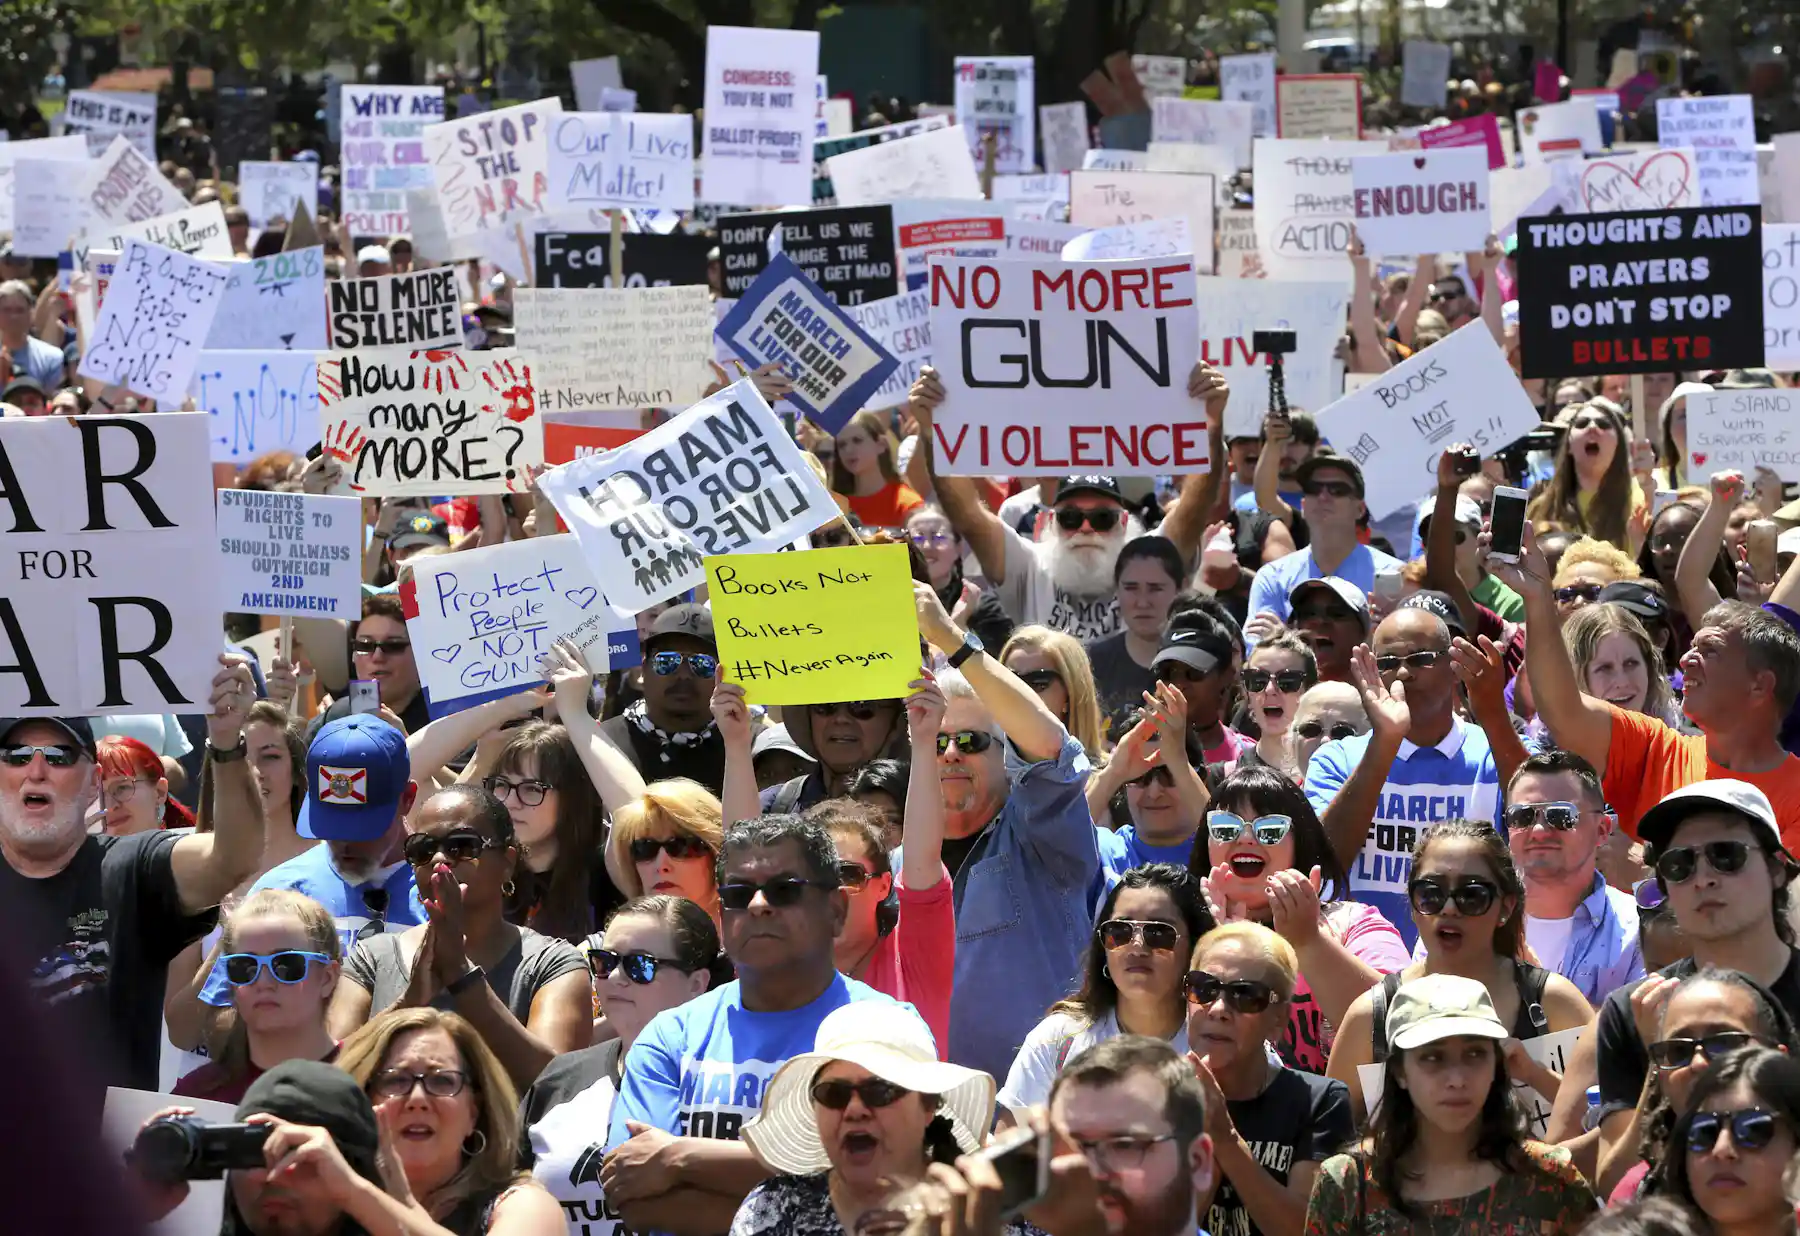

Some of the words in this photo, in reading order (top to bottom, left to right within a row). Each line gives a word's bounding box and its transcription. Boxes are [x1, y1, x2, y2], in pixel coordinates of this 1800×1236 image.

[723, 69, 796, 86] CONGRESS:
[352, 93, 403, 116] WHY
[770, 92, 794, 108] NOT
[457, 112, 538, 157] STOP
[555, 117, 610, 154] Our
[628, 120, 690, 160] Lives
[476, 154, 521, 181] THE
[566, 162, 665, 199] Matter!
[1094, 184, 1134, 206] The
[1354, 181, 1487, 218] ENOUGH.
[820, 223, 841, 239] US
[849, 222, 873, 238] WE
[1278, 222, 1350, 250] ACTIO
[1528, 216, 1682, 248] THOUGHTS
[1692, 213, 1752, 238] AND
[254, 249, 320, 285] 2018
[544, 234, 625, 269] Fea
[726, 253, 757, 270] CAN
[839, 245, 868, 259] THE
[824, 265, 851, 281] GET
[856, 262, 891, 278] MAD
[931, 264, 1001, 310] NO
[1032, 263, 1194, 312] MORE
[1569, 256, 1710, 289] PRAYERS
[330, 279, 379, 314] NO
[390, 270, 457, 311] MORE
[333, 305, 457, 349] SILENCE
[778, 290, 852, 361] MARCH
[1550, 297, 1636, 329] DON'T
[1650, 294, 1731, 322] STOP
[105, 314, 191, 360] NOT
[763, 307, 806, 353] FOR
[798, 343, 848, 388] OUR
[961, 317, 1171, 389] GUN
[1202, 337, 1285, 366] LIV
[1572, 336, 1711, 365] BULLETS
[748, 325, 806, 384] LIVES
[1373, 359, 1448, 409] BOOKS
[368, 398, 478, 437] many
[1412, 400, 1451, 436] NOT
[1705, 396, 1720, 416] I
[1731, 394, 1791, 414] STAND
[1722, 417, 1764, 431] with
[353, 425, 525, 485] MORE?
[932, 421, 1210, 467] VIOLENCE
[1752, 449, 1800, 465] VIOLENC
[222, 490, 304, 511] STUDENTS
[243, 507, 305, 526] RIGHTS
[311, 512, 333, 529] TO
[268, 525, 304, 541] LIVE
[18, 550, 99, 580] FOR
[220, 538, 282, 558] SHOULD
[288, 543, 350, 561] ALWAYS
[251, 557, 331, 577] OUTWEIGH
[271, 575, 304, 590] 2ND
[715, 564, 808, 595] Books
[818, 568, 874, 589] Not
[240, 592, 338, 613] AMENDMENT
[434, 560, 563, 619] Protect
[469, 598, 545, 637] People
[727, 617, 824, 639] Bullets
[482, 625, 548, 658] NOT
